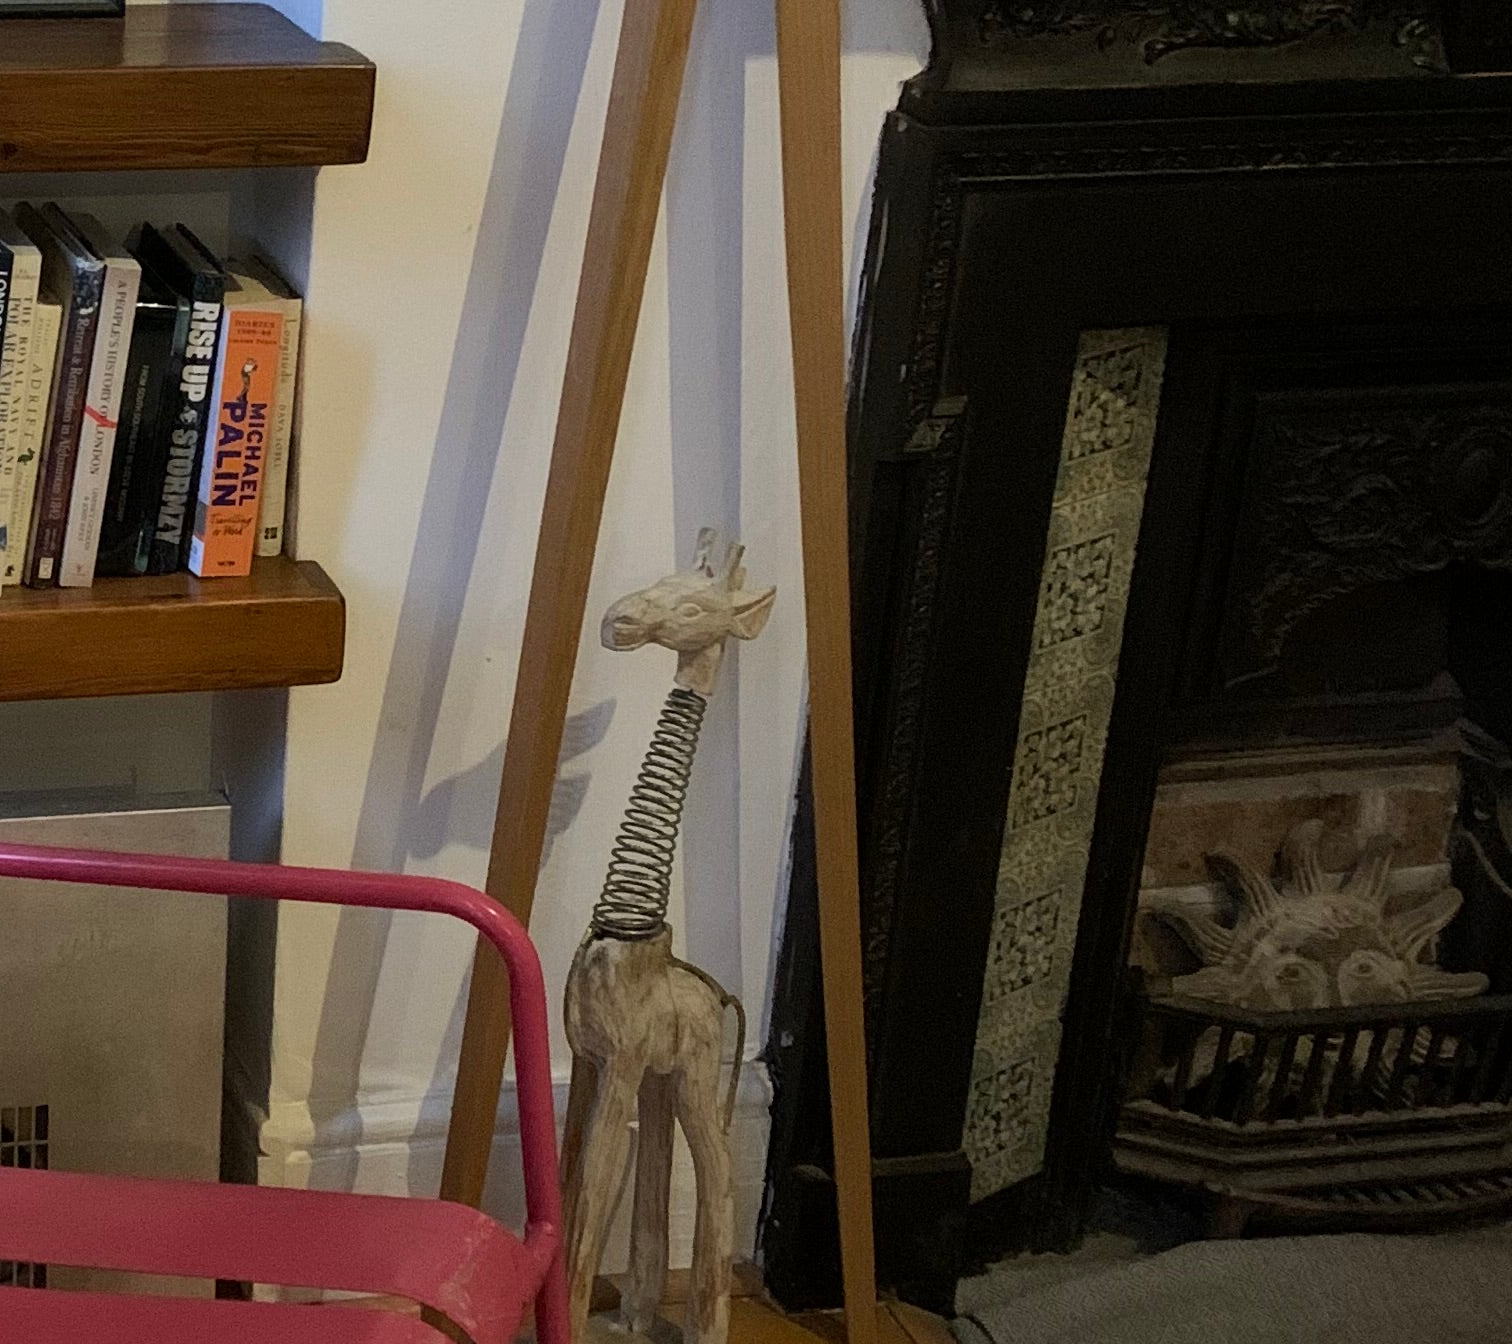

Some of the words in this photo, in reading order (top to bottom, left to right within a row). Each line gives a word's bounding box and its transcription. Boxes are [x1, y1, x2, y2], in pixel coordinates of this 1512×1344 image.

[117, 279, 127, 289] A
[3, 296, 23, 354] POLAR
[19, 295, 34, 328] THE
[71, 317, 89, 355] Retreat
[106, 289, 127, 348] PEOPLE'S
[185, 301, 223, 359] RISE
[13, 335, 29, 388] ROYAL
[98, 350, 118, 402] HISTORY
[280, 318, 296, 384] Longitude
[24, 363, 44, 442] ADRIFT
[61, 367, 85, 423] Retribution
[178, 364, 210, 402] UP
[6, 396, 23, 438] NAVY
[60, 424, 72, 434] in
[1, 445, 17, 477] AND
[51, 436, 72, 494] Afghanistan
[211, 401, 249, 508] PALIN
[238, 403, 268, 507] MICHAEL
[46, 496, 63, 521] 1842
[153, 429, 199, 545] STORMZY
